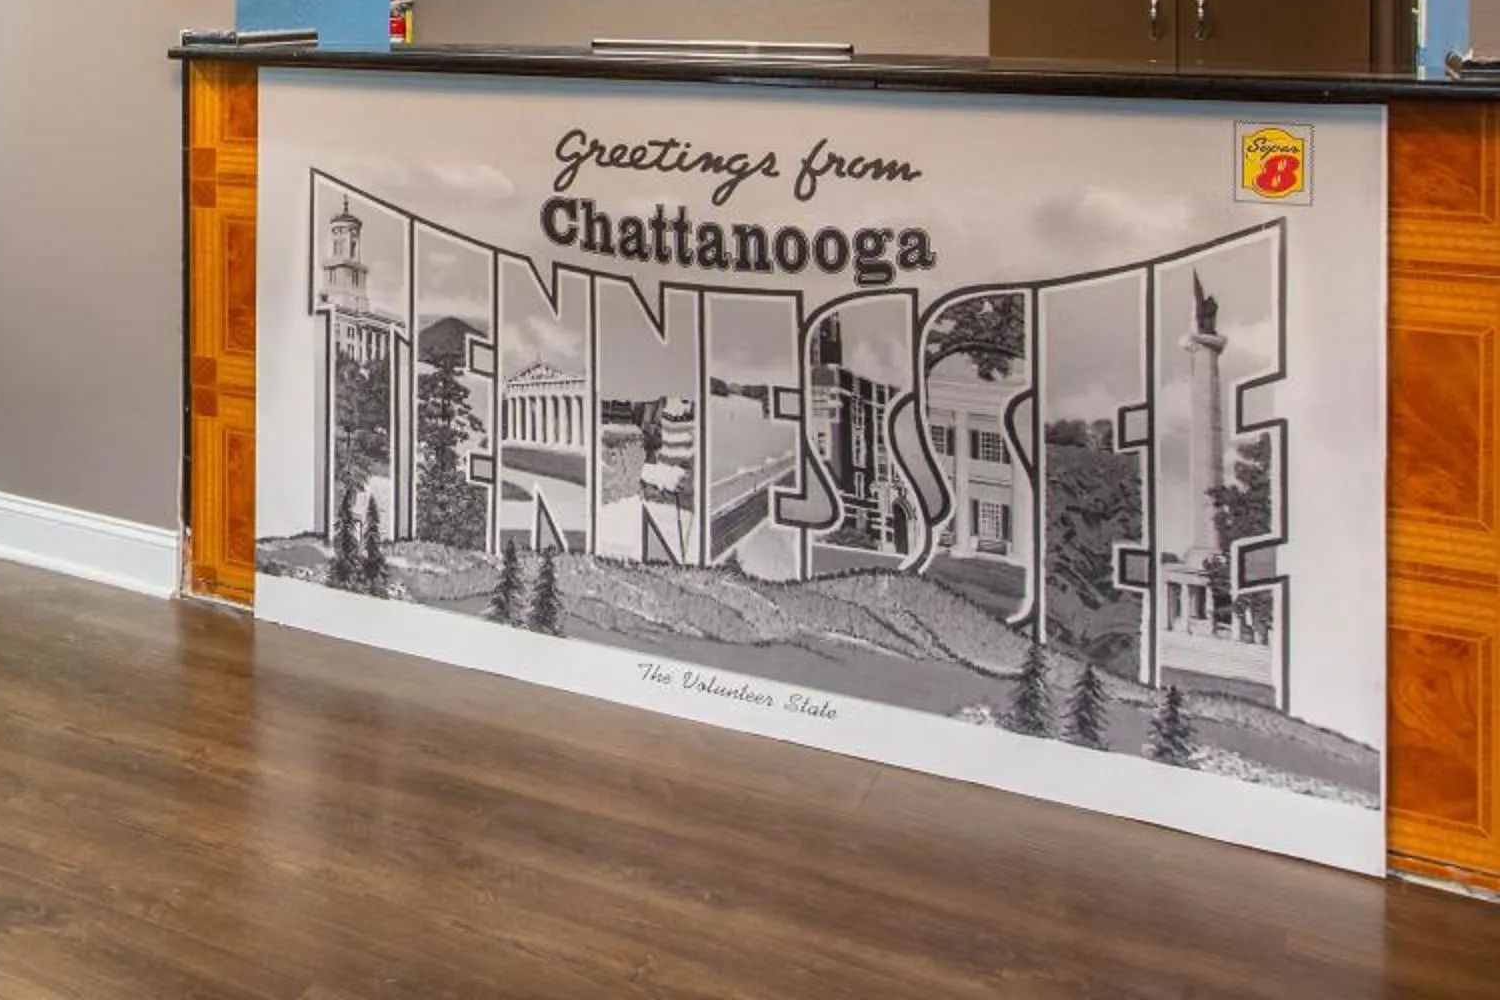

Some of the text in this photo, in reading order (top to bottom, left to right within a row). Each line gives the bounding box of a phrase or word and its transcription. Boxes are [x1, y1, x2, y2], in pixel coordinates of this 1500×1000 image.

[554, 128, 923, 206] Greetings from
[1246, 136, 1301, 160] Super
[1255, 154, 1301, 193] 8
[539, 196, 938, 287] Chattanooga
[308, 166, 1290, 714] TENNESSEE
[637, 662, 838, 721] The Volunteer State
